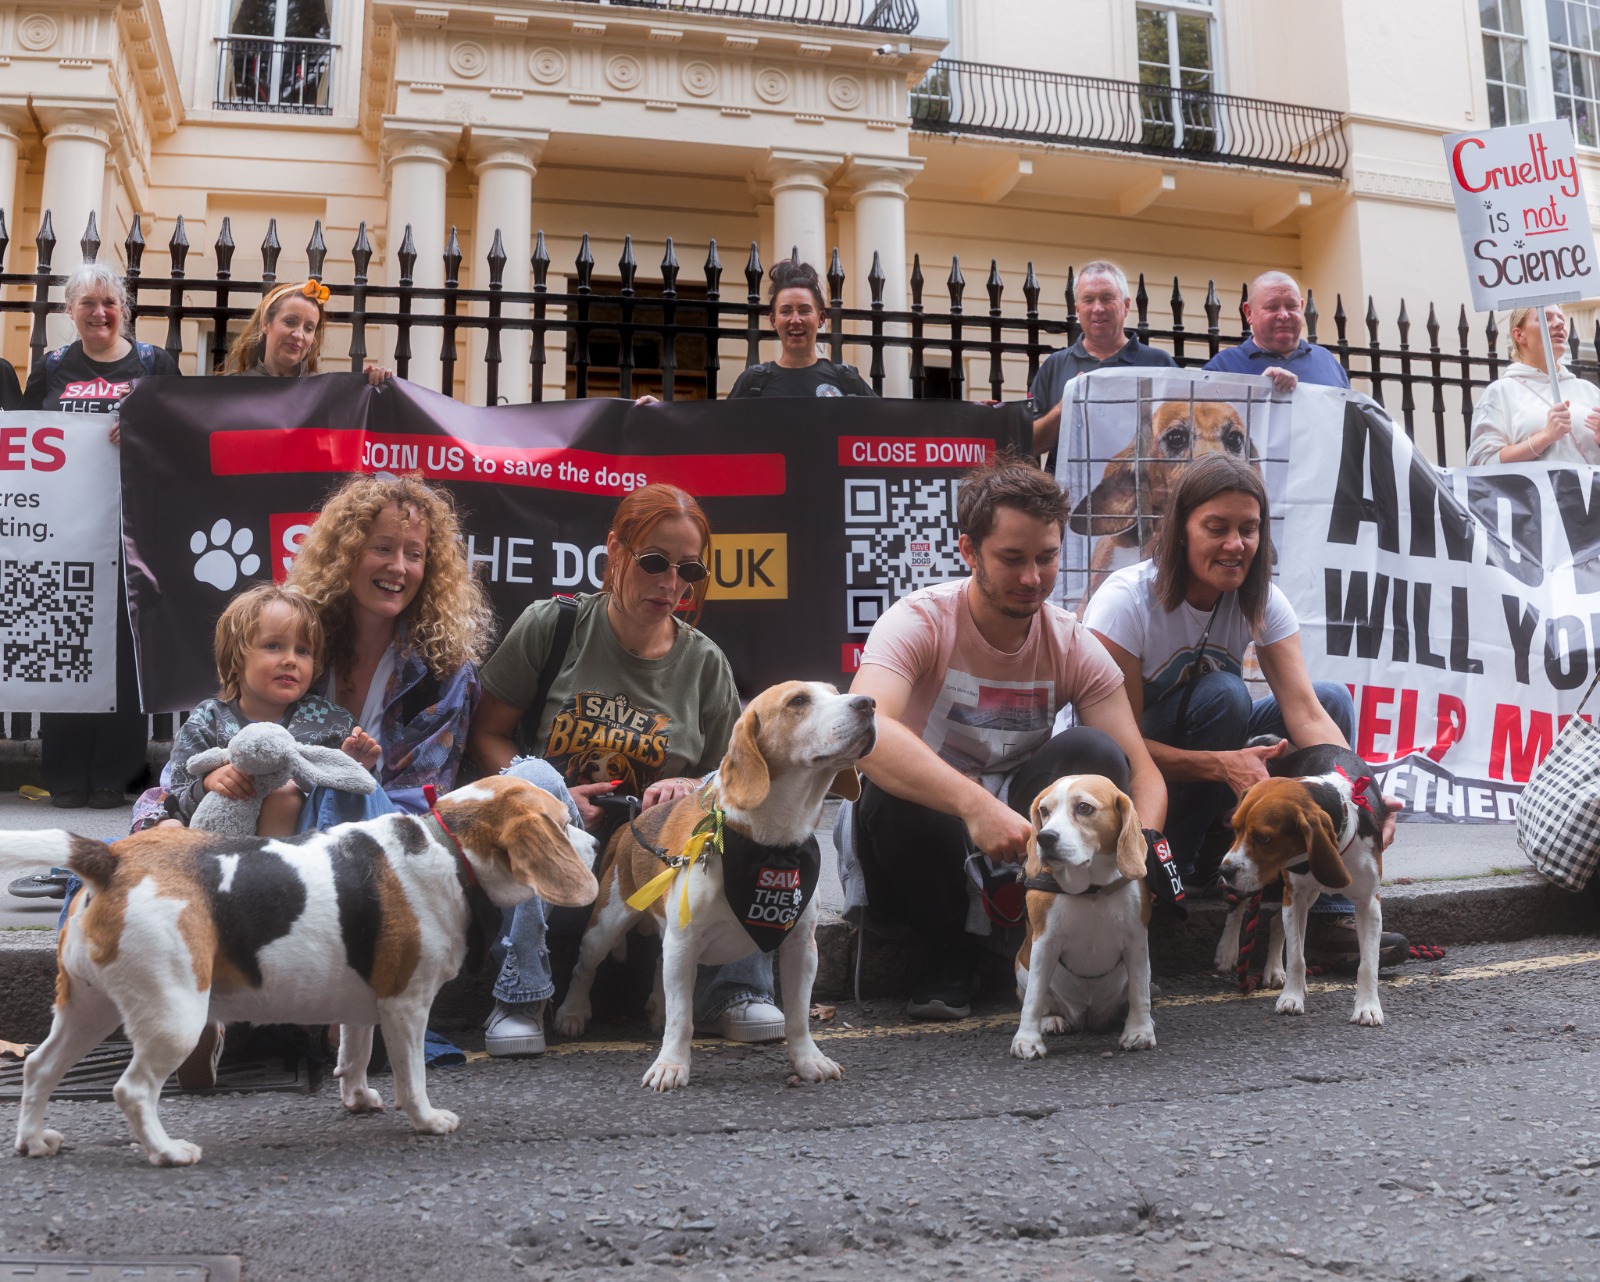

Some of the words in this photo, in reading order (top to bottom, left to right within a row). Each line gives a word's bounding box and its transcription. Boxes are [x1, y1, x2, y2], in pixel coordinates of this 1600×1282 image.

[1453, 133, 1579, 198] Cruelty
[1489, 212, 1510, 234] is
[1523, 195, 1567, 230] not
[1474, 239, 1592, 289] Science
[362, 441, 419, 469] JOIN
[427, 445, 465, 472] US
[472, 455, 497, 474] to
[503, 459, 553, 479] save
[558, 461, 590, 484] the
[595, 466, 648, 492] dogs
[852, 442, 917, 462] CLOSE
[925, 443, 986, 463] DOWN
[0, 492, 40, 508] res
[453, 534, 534, 584] HE
[552, 542, 609, 589] DO
[715, 548, 776, 588] UK
[911, 543, 929, 551] SAVE
[1325, 567, 1484, 675] WILL
[586, 696, 649, 732] SAVE
[1345, 684, 1467, 764] ELP
[544, 712, 669, 768] BEAGLES
[748, 903, 800, 924] DOGS
[755, 889, 792, 906] THE
